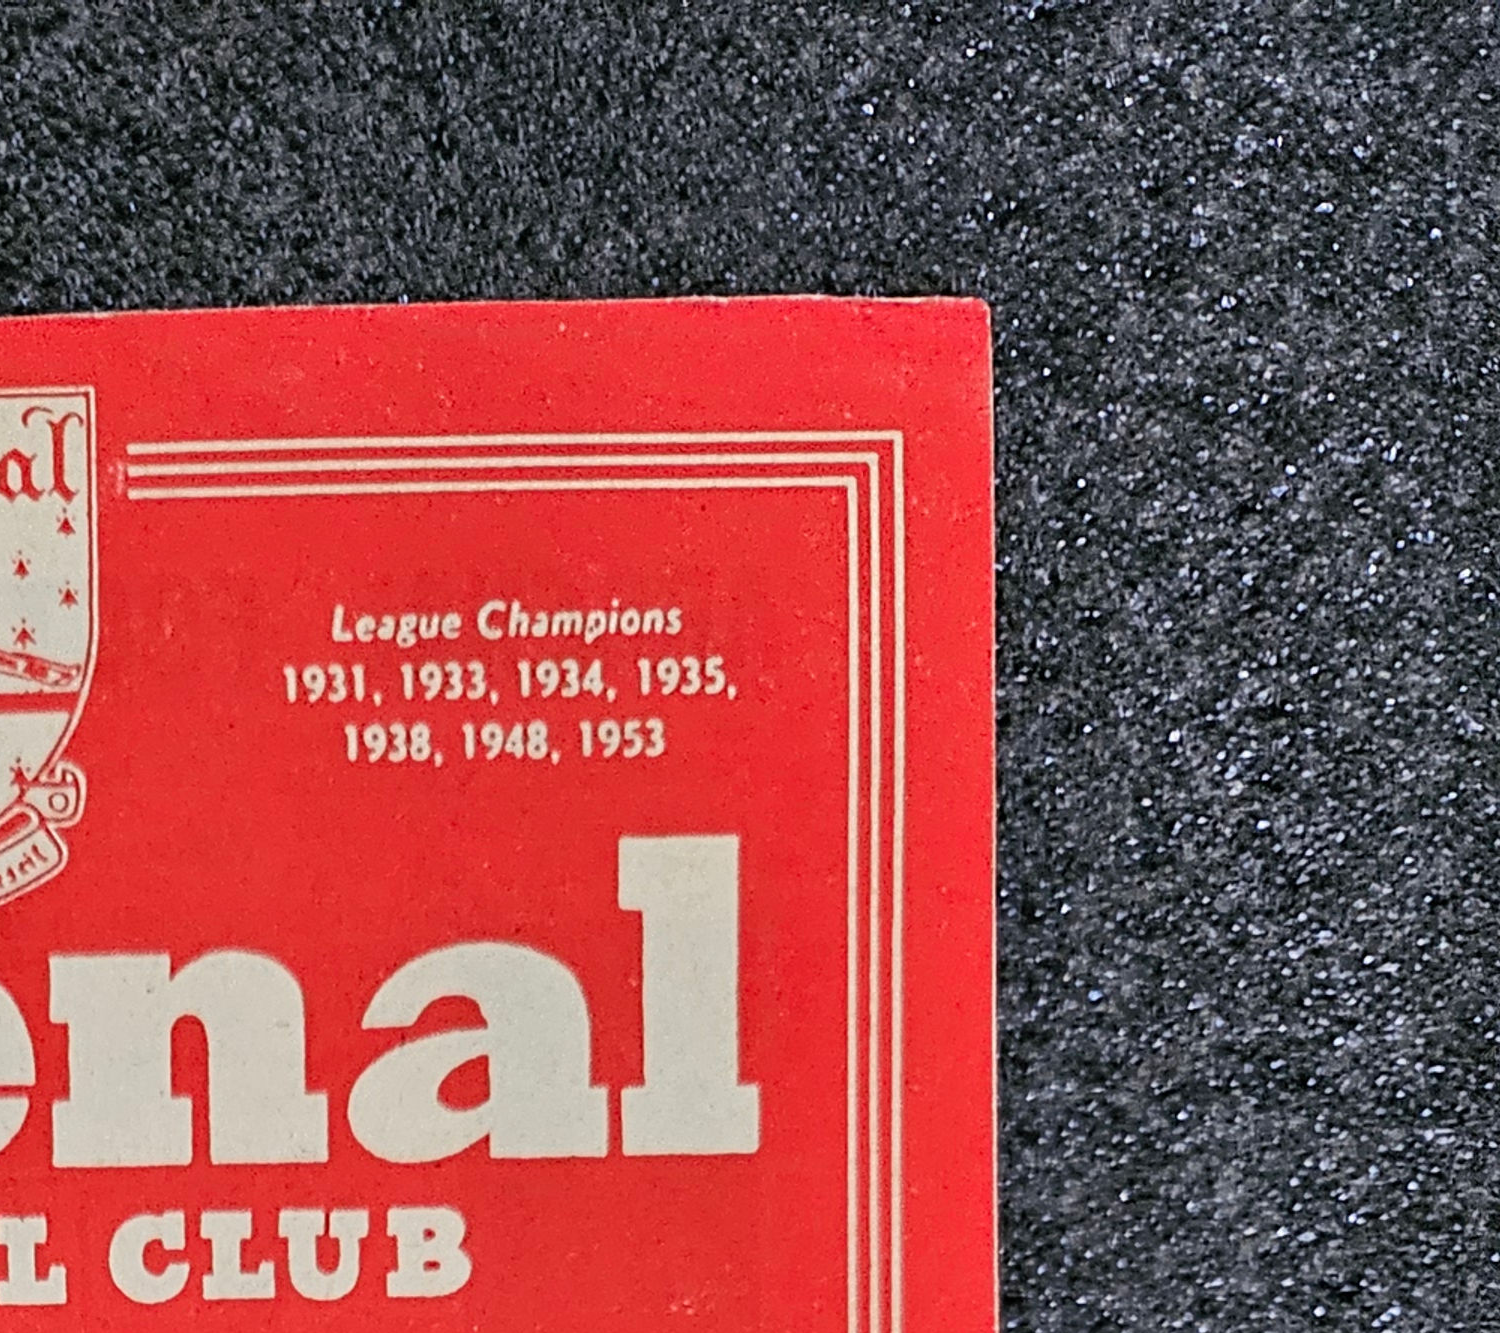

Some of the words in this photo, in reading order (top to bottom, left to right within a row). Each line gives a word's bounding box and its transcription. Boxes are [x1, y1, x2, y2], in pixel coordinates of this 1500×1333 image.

[330, 603, 463, 649] League
[476, 597, 683, 646] Champions
[282, 662, 383, 708] 1931,
[399, 659, 500, 706] 1933,
[516, 657, 618, 704] 1934,
[636, 654, 738, 701] 1935,
[343, 721, 444, 768] 1938,
[461, 718, 561, 766] 1948,
[578, 716, 667, 759] 1953
[107, 1204, 474, 1306] CLUB
